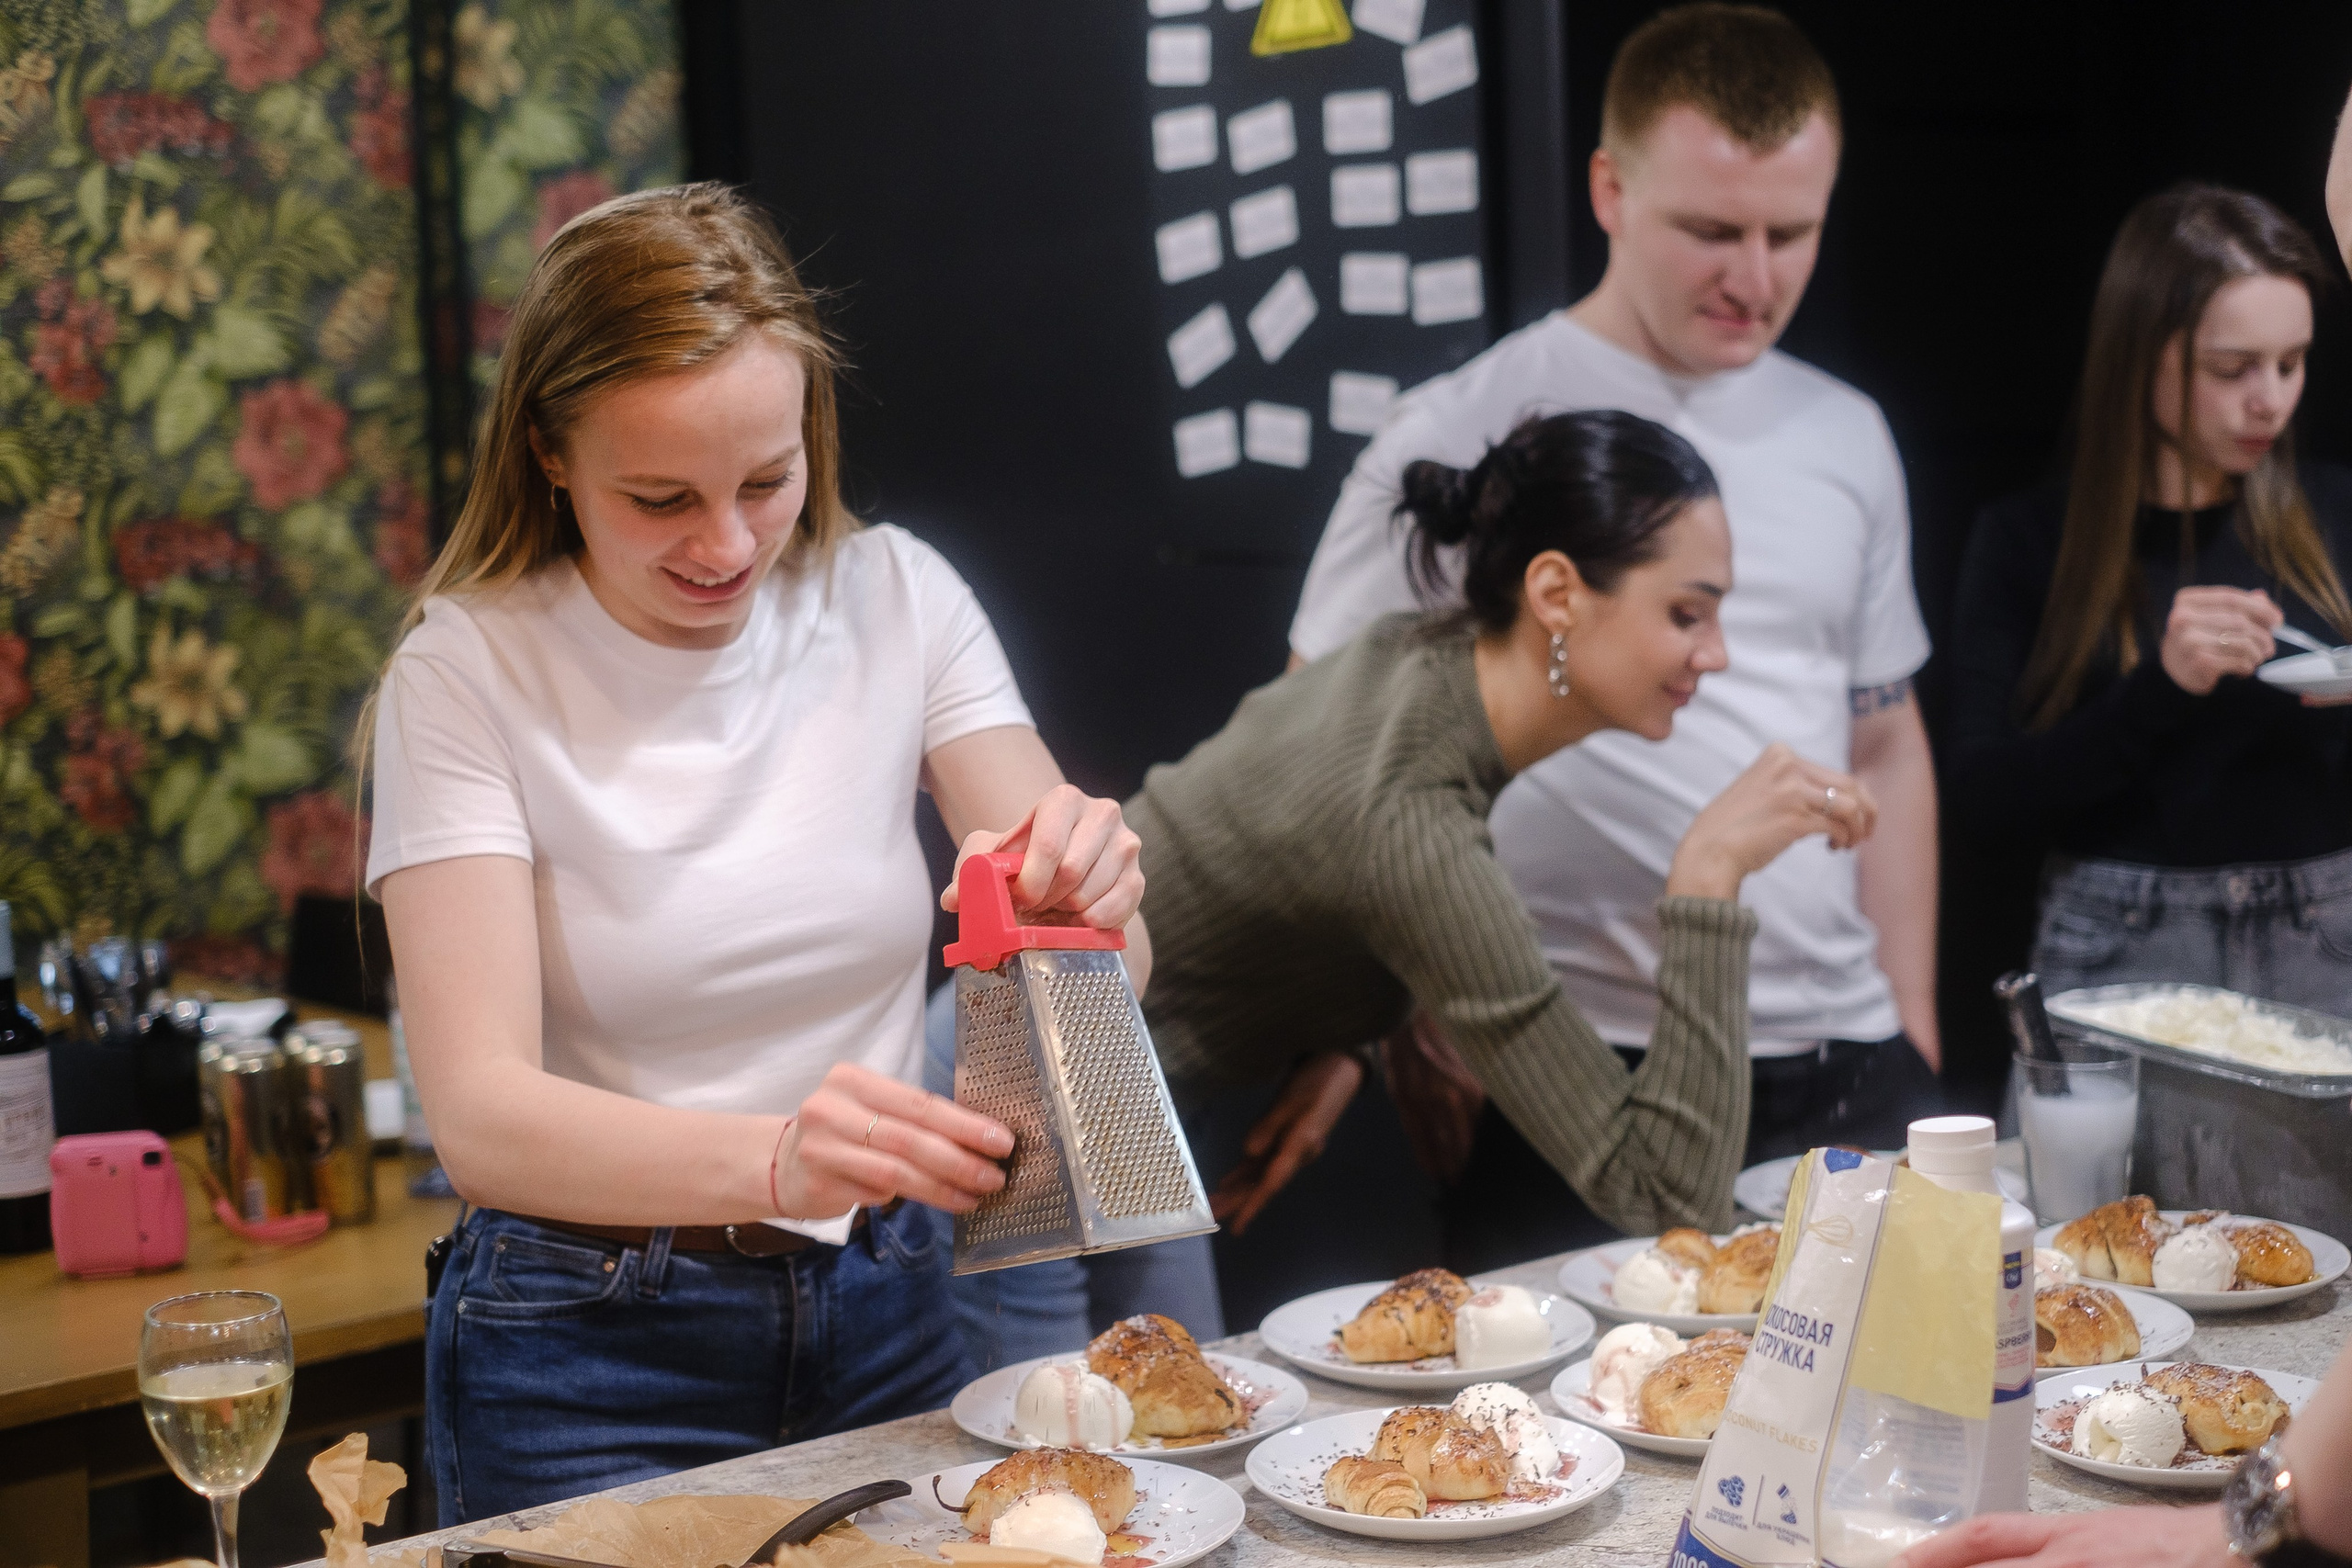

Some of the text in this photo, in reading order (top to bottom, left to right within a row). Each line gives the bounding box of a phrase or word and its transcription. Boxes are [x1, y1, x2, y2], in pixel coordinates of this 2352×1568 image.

[1765, 1303, 1834, 1347] ОКОСОВАЯ
[1755, 1330, 1814, 1372] СТРУЖКА
[1769, 1426, 1818, 1453] FLAKES
[1672, 1550, 1709, 1568] 10
